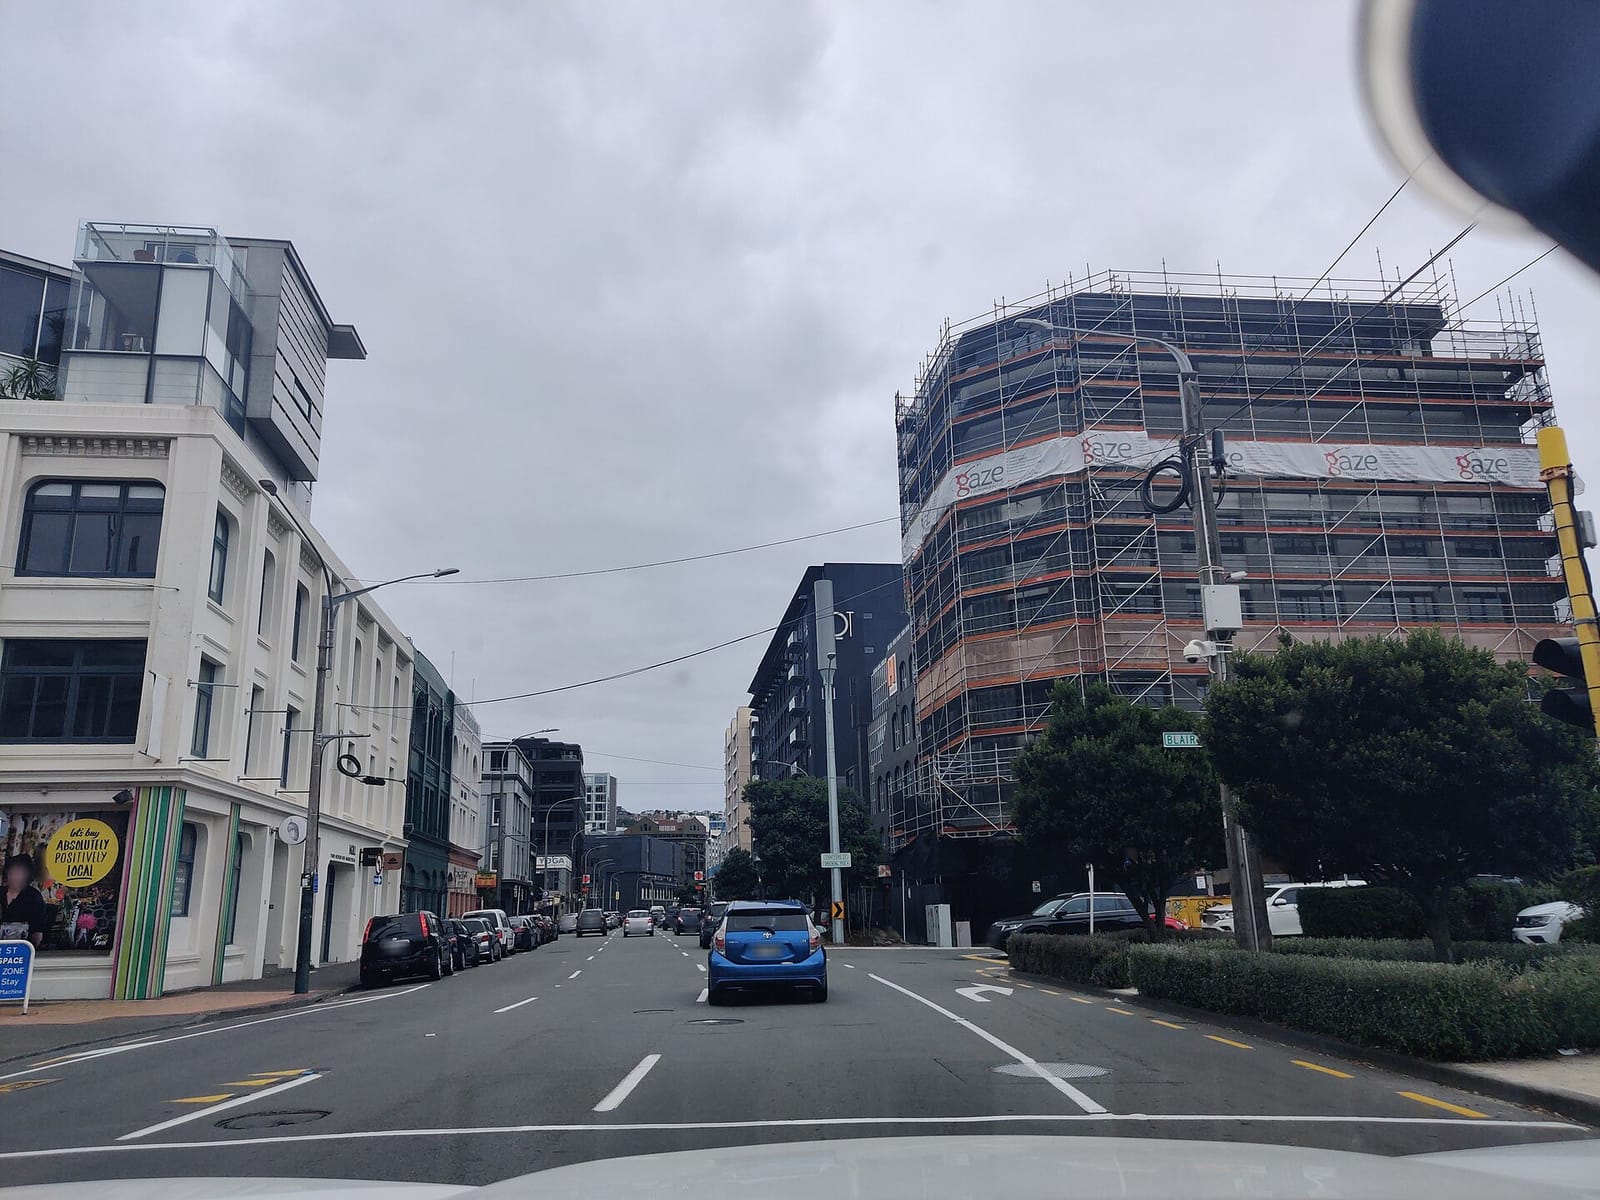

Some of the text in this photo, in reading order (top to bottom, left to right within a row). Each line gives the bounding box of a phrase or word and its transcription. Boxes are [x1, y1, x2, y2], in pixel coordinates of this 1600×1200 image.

[1081, 438, 1132, 464] gaze
[1324, 451, 1378, 475] gaze
[1456, 454, 1509, 479] gaze
[956, 465, 1004, 497] gaze
[1167, 735, 1196, 745] BLAIR
[85, 827, 101, 839] buy
[56, 839, 110, 851] ABSOLUTELY
[55, 852, 108, 863] POSITIVELY
[538, 857, 565, 865] YOGA
[67, 864, 93, 877] LOCAL
[6, 946, 18, 954] ST
[0, 957, 23, 965] SPACE
[2, 967, 24, 975] ZONE
[1, 978, 19, 986] Stay
